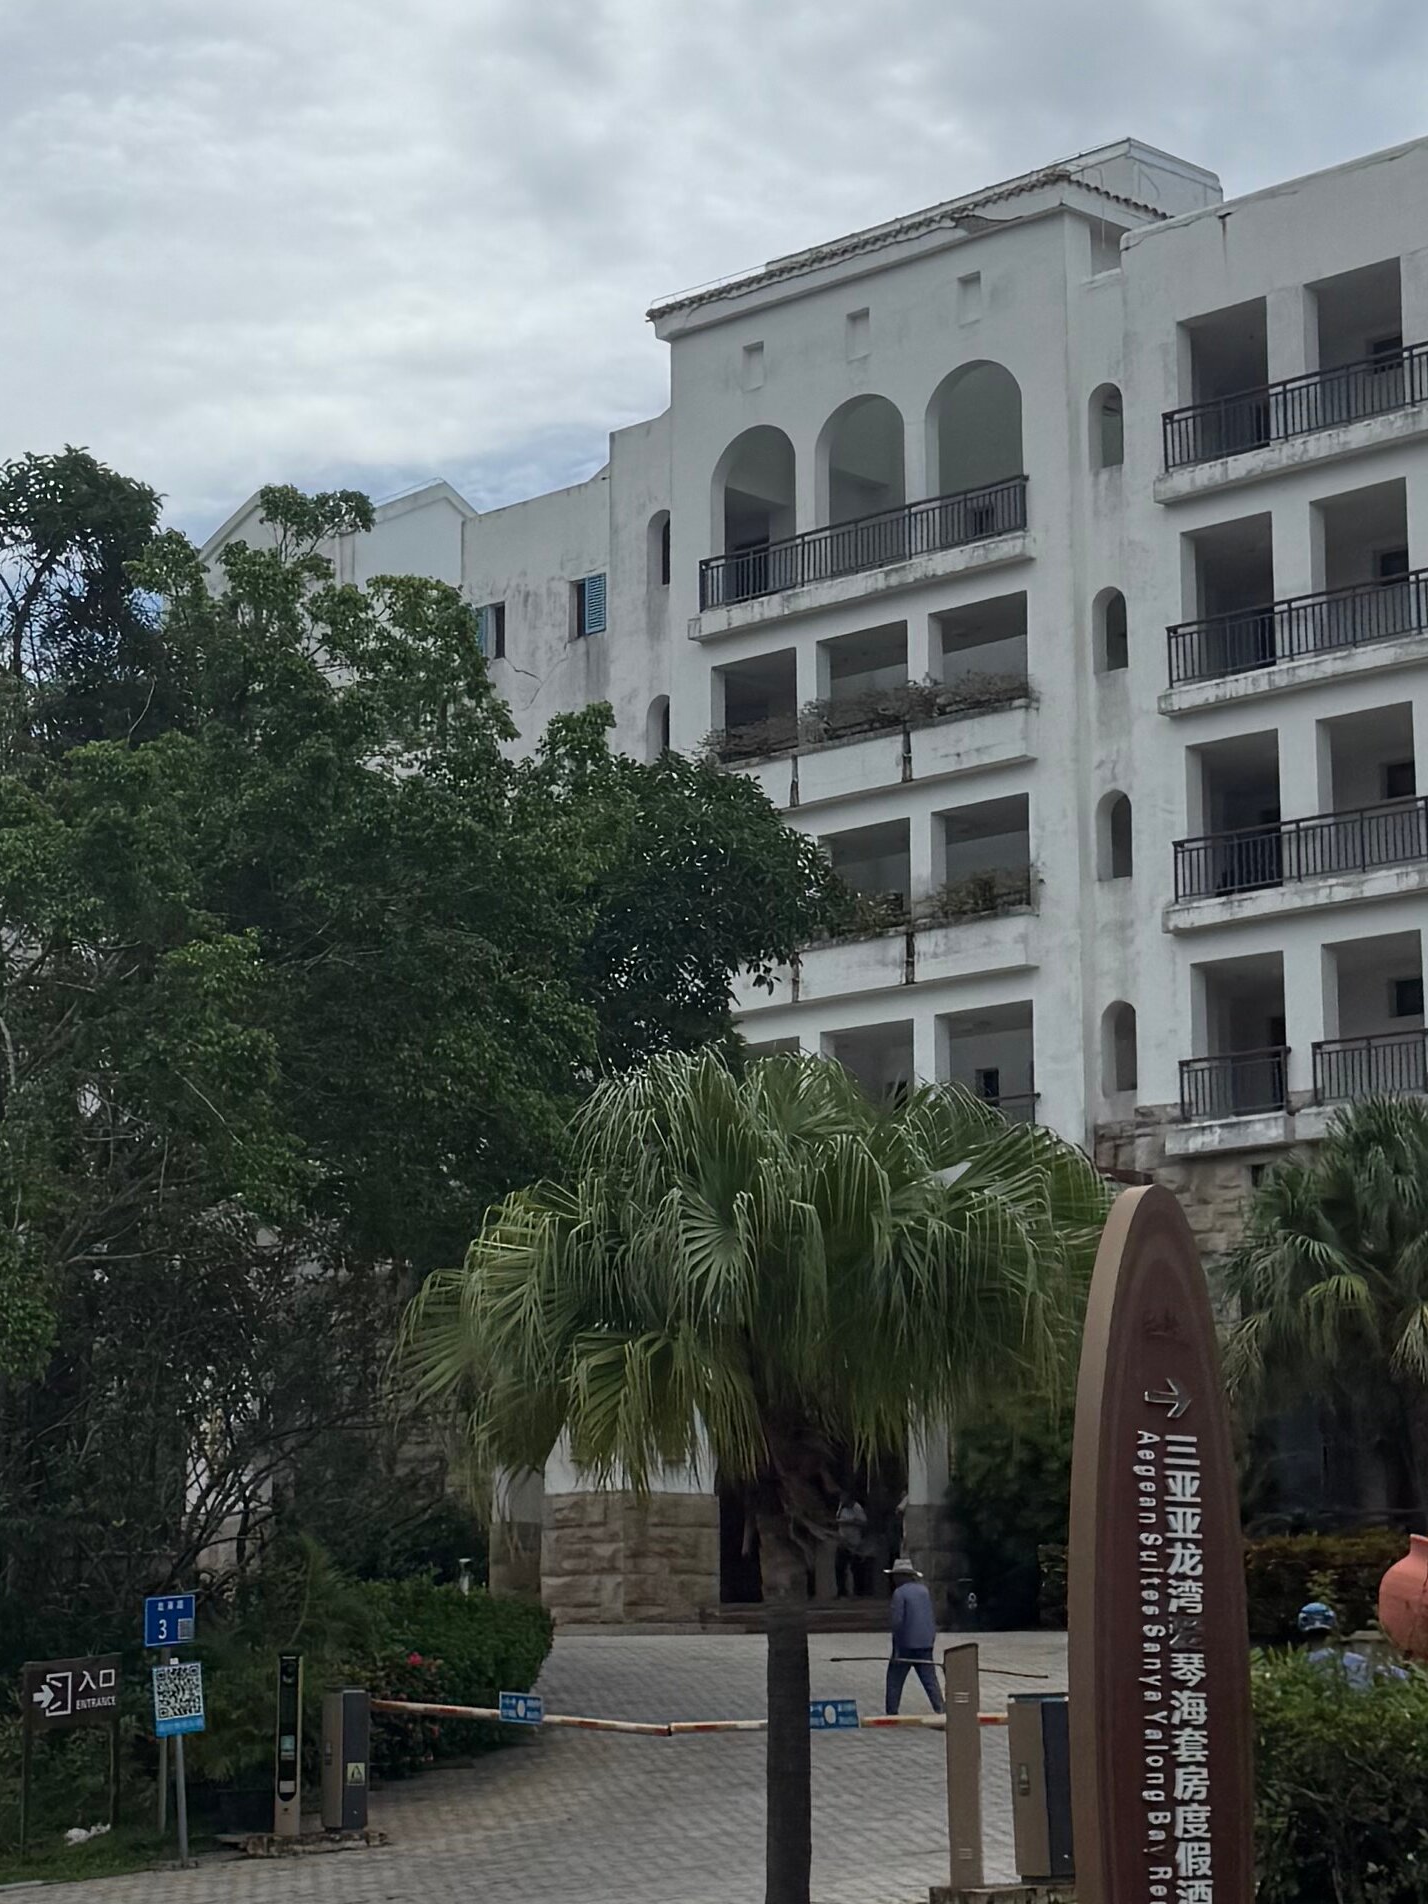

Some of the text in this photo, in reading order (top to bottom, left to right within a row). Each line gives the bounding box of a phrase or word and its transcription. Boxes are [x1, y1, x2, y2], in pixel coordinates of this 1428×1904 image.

[1133, 1430, 1161, 1524] Aegean
[1139, 1532, 1164, 1615] Suites
[158, 1619, 168, 1640] 3
[1138, 1624, 1166, 1701] Sanya
[75, 1696, 117, 1710] ENTRANCE
[78, 1669, 115, 1692] 入口
[1142, 1710, 1170, 1801] Yalong
